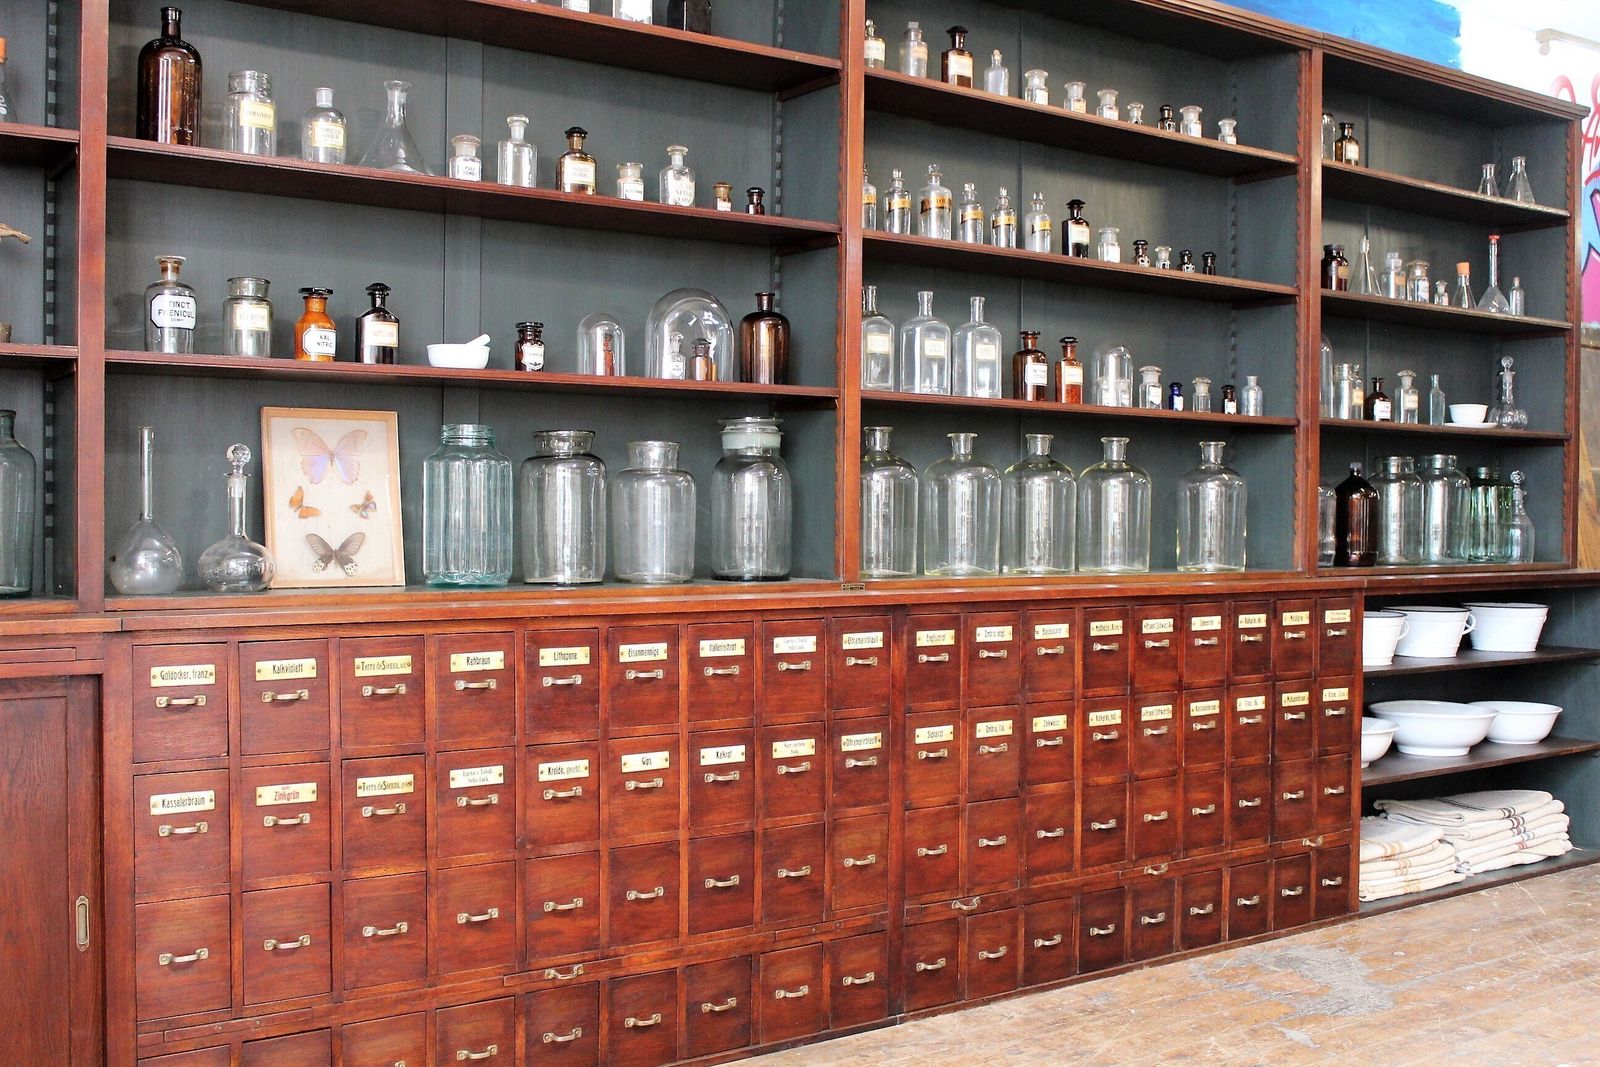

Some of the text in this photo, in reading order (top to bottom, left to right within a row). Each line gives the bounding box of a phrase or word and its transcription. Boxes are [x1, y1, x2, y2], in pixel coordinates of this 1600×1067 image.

[467, 656, 491, 666] Rehbraun
[273, 664, 303, 675] Kalkviolett
[641, 756, 652, 766] Gips
[162, 796, 205, 809] Kasselerbraun
